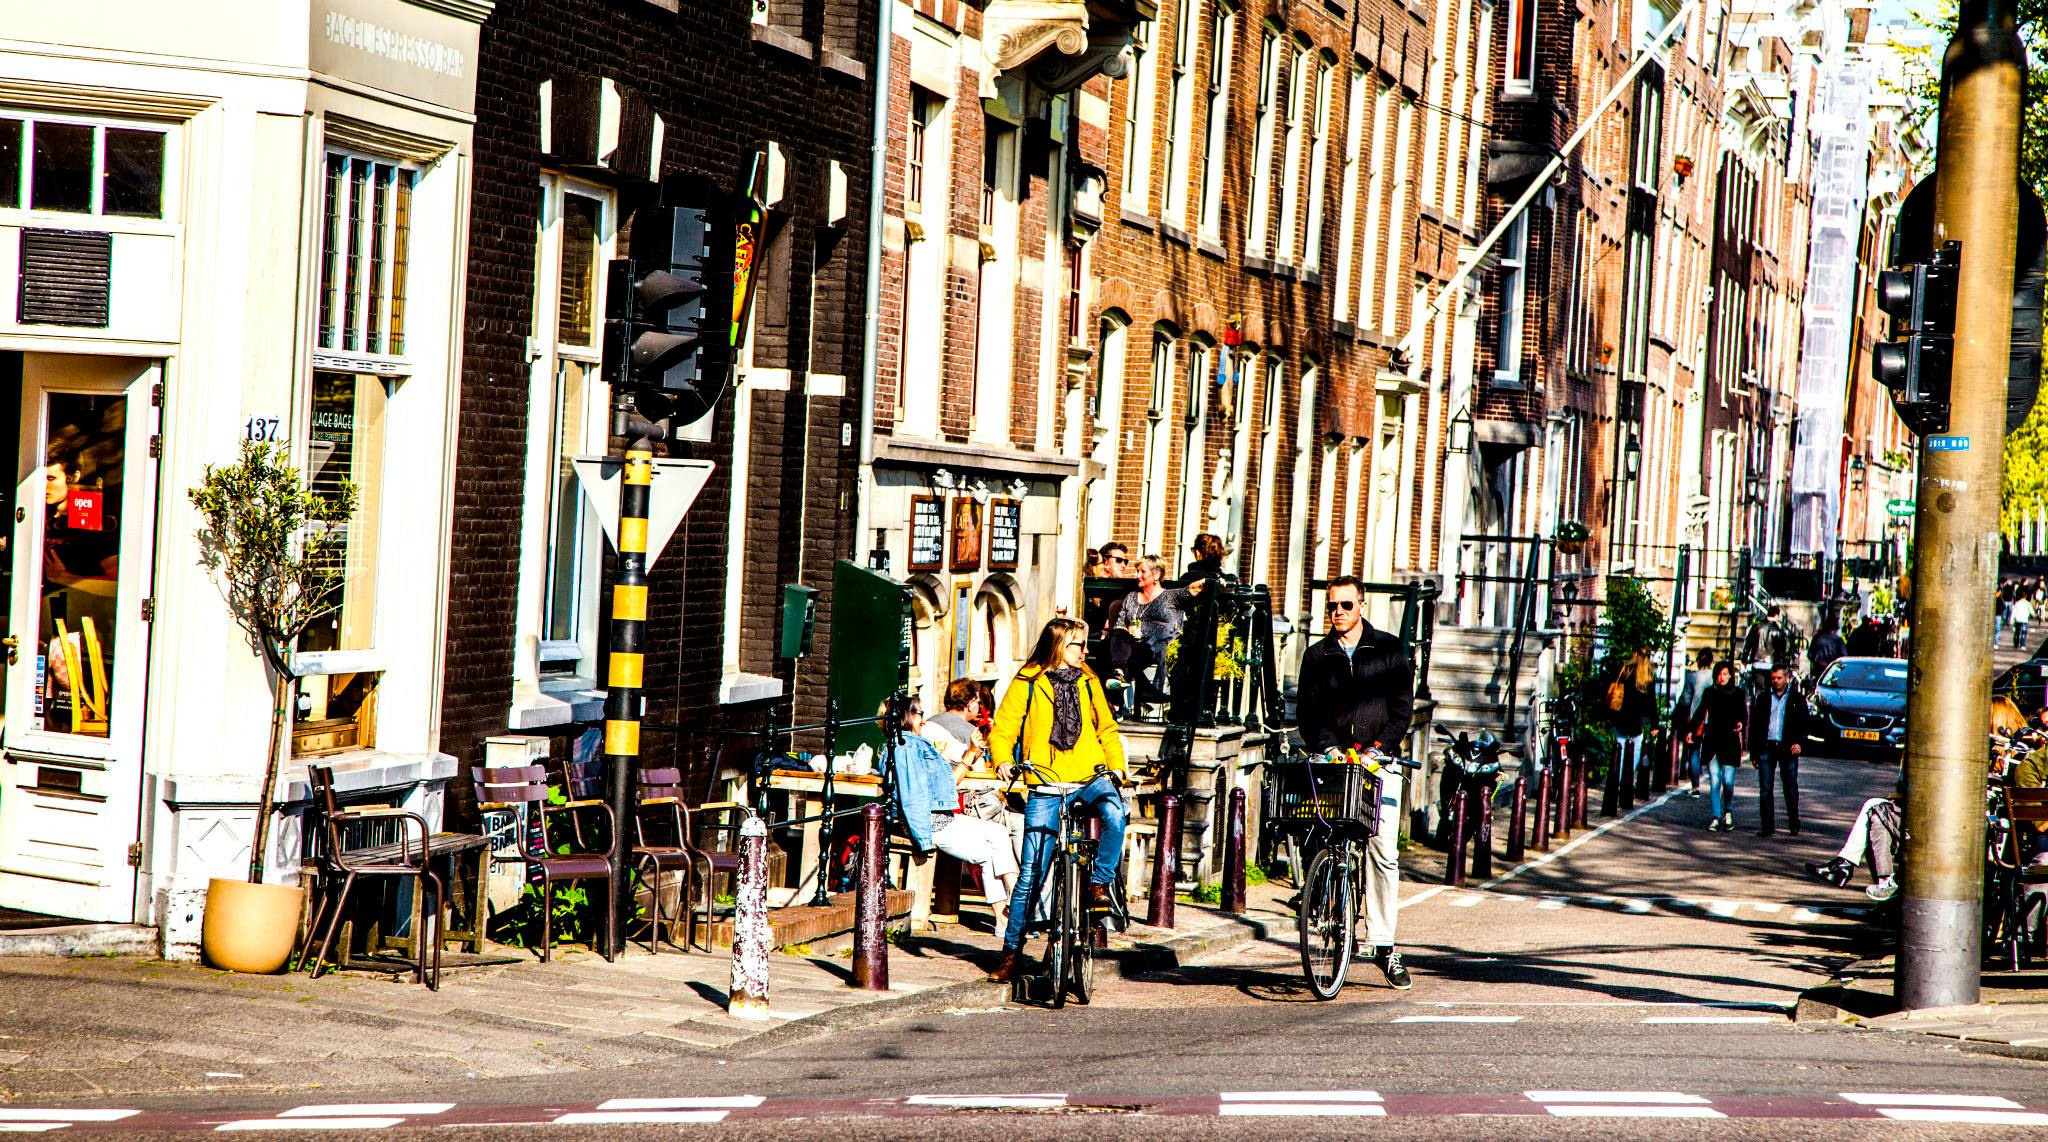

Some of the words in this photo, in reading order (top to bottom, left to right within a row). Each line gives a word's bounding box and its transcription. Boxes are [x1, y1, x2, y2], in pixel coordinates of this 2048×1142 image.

[325, 11, 367, 50] BAGEL
[375, 26, 437, 70] ESPRESSO
[442, 45, 464, 78] BAR
[246, 418, 279, 442] 137
[74, 498, 93, 511] open
